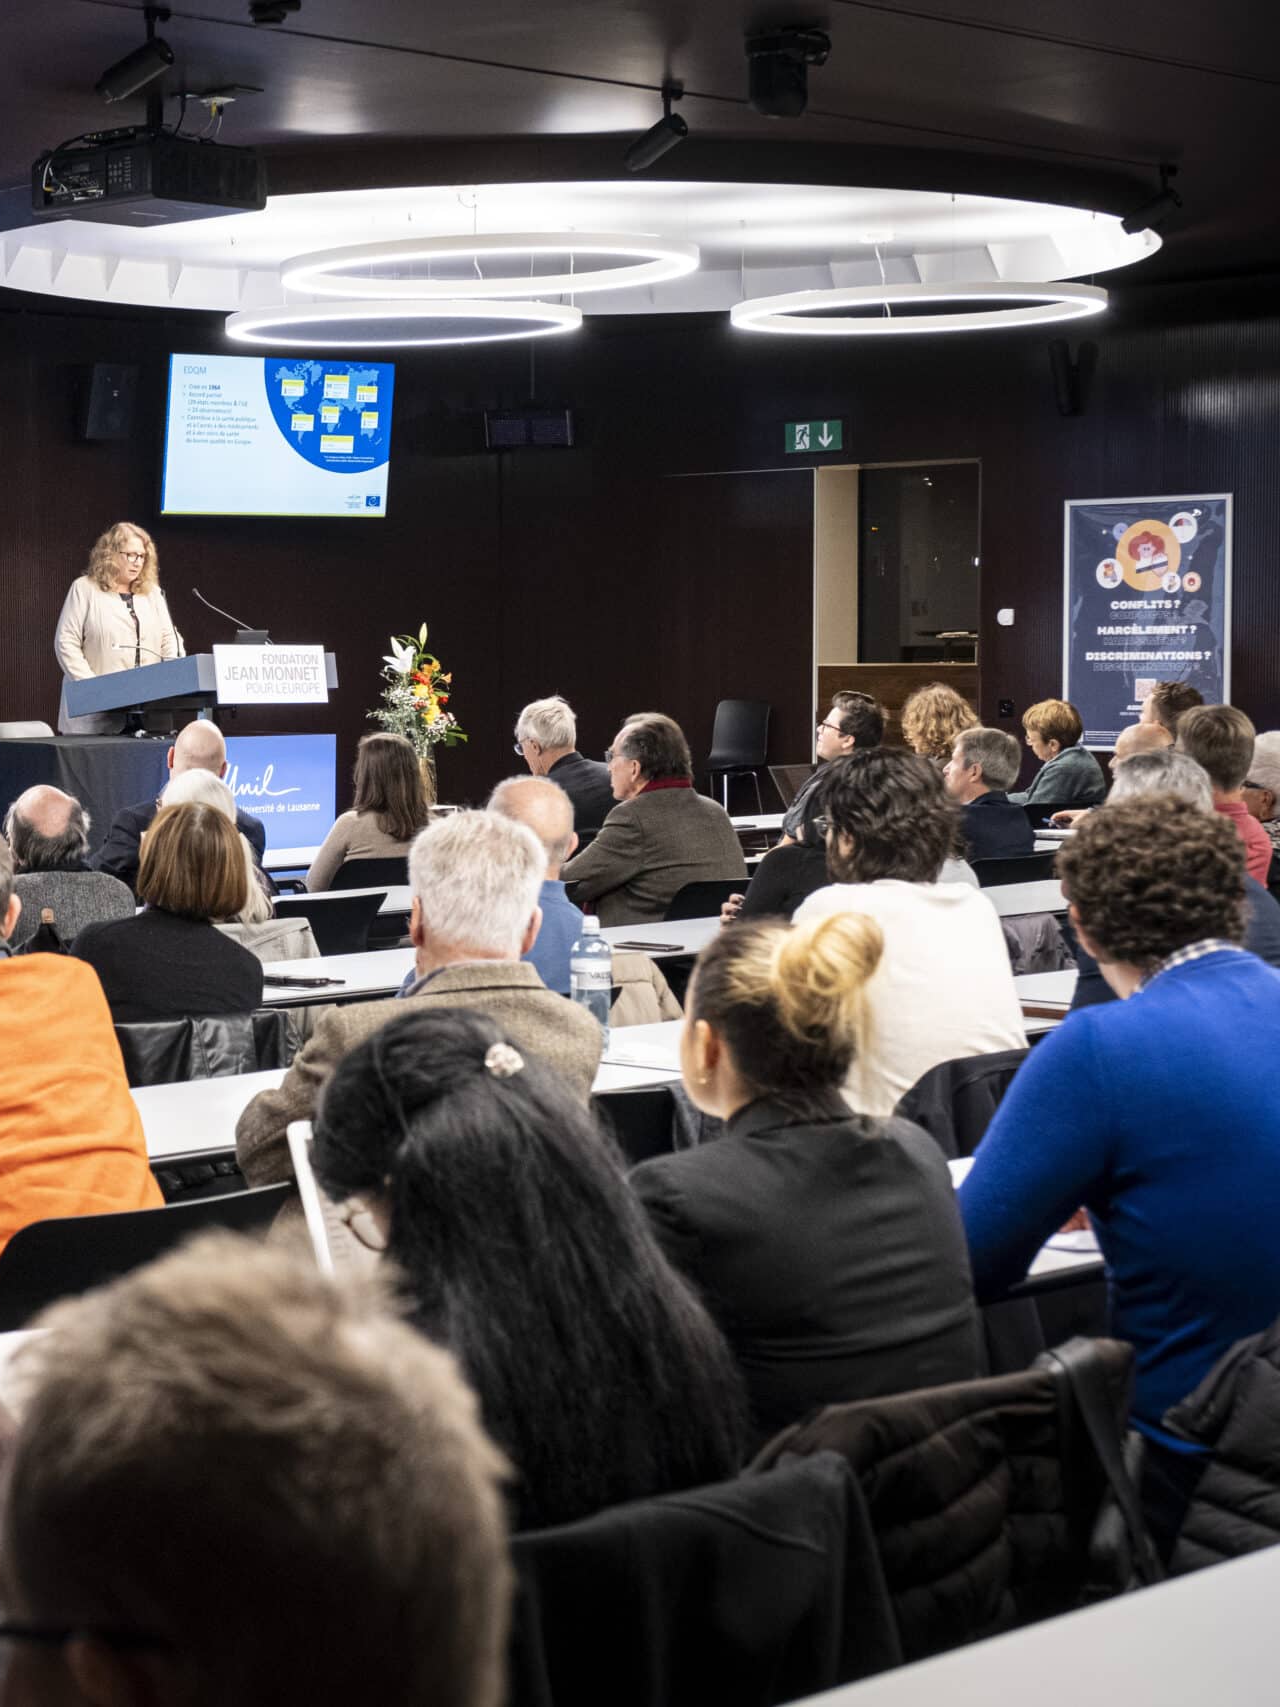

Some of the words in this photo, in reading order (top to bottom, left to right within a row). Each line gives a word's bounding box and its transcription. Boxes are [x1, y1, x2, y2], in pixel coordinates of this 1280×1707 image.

[1110, 600, 1172, 610] CONFLITS
[262, 653, 319, 665] FONDATION
[1085, 651, 1203, 661] DISCRIMINATIONS
[224, 666, 259, 681] JEAN
[262, 666, 319, 681] MONNET
[246, 682, 273, 694] POUR
[276, 803, 286, 813] de
[287, 802, 321, 813] Lausanne
